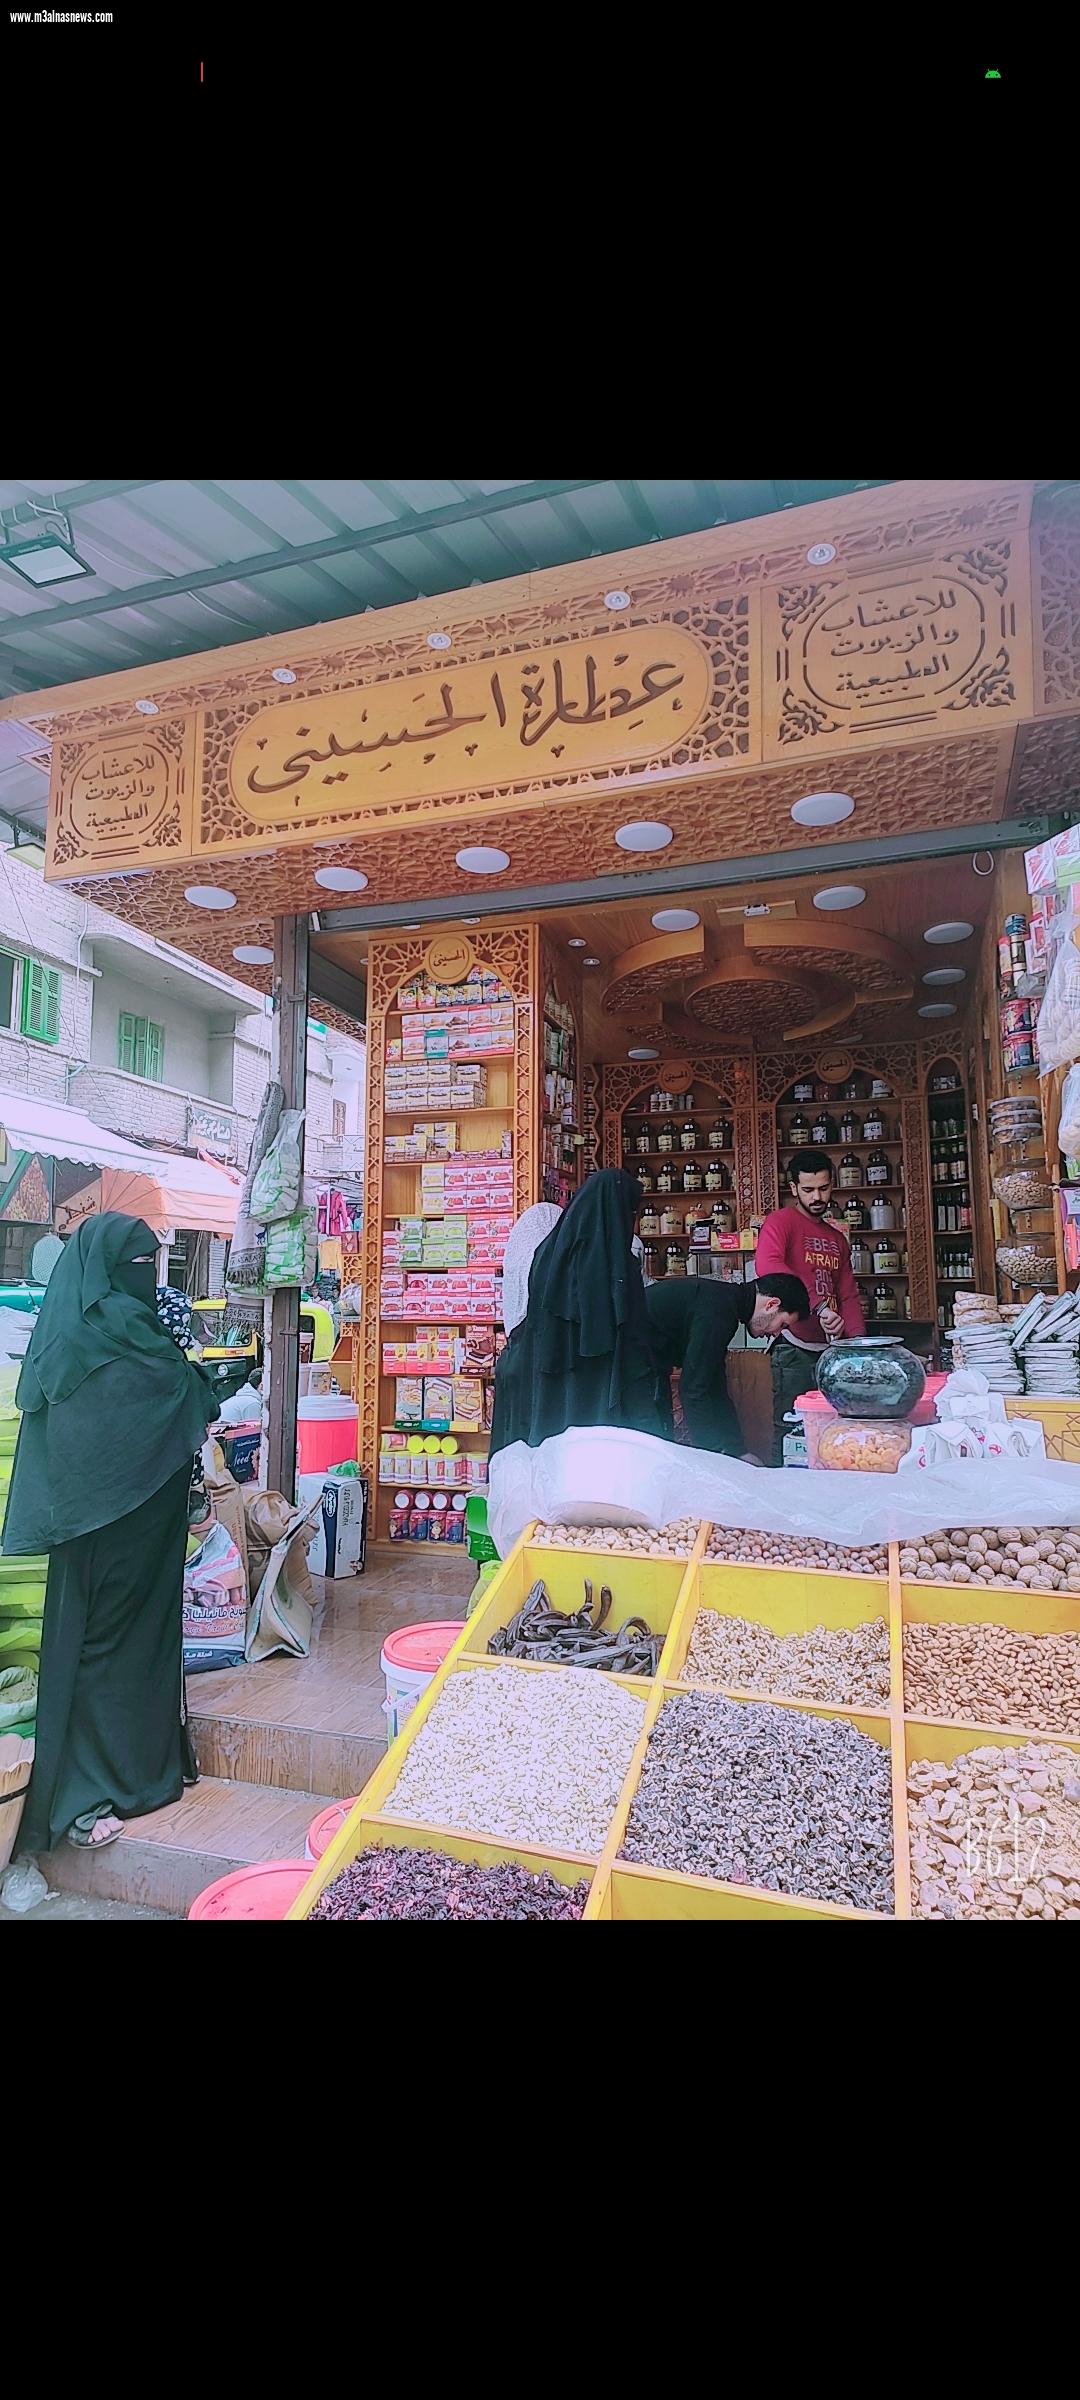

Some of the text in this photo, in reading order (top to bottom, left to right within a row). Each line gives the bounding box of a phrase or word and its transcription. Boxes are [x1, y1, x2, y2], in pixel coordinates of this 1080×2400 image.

[821, 589, 957, 632] للاعشاب
[836, 653, 950, 699] الطبيعية
[519, 654, 685, 757] عطارة
[81, 753, 156, 782] للاعشاب
[85, 802, 151, 833] الطبيعية
[813, 1237, 830, 1252] BE
[805, 1252, 839, 1270] AFRAID
